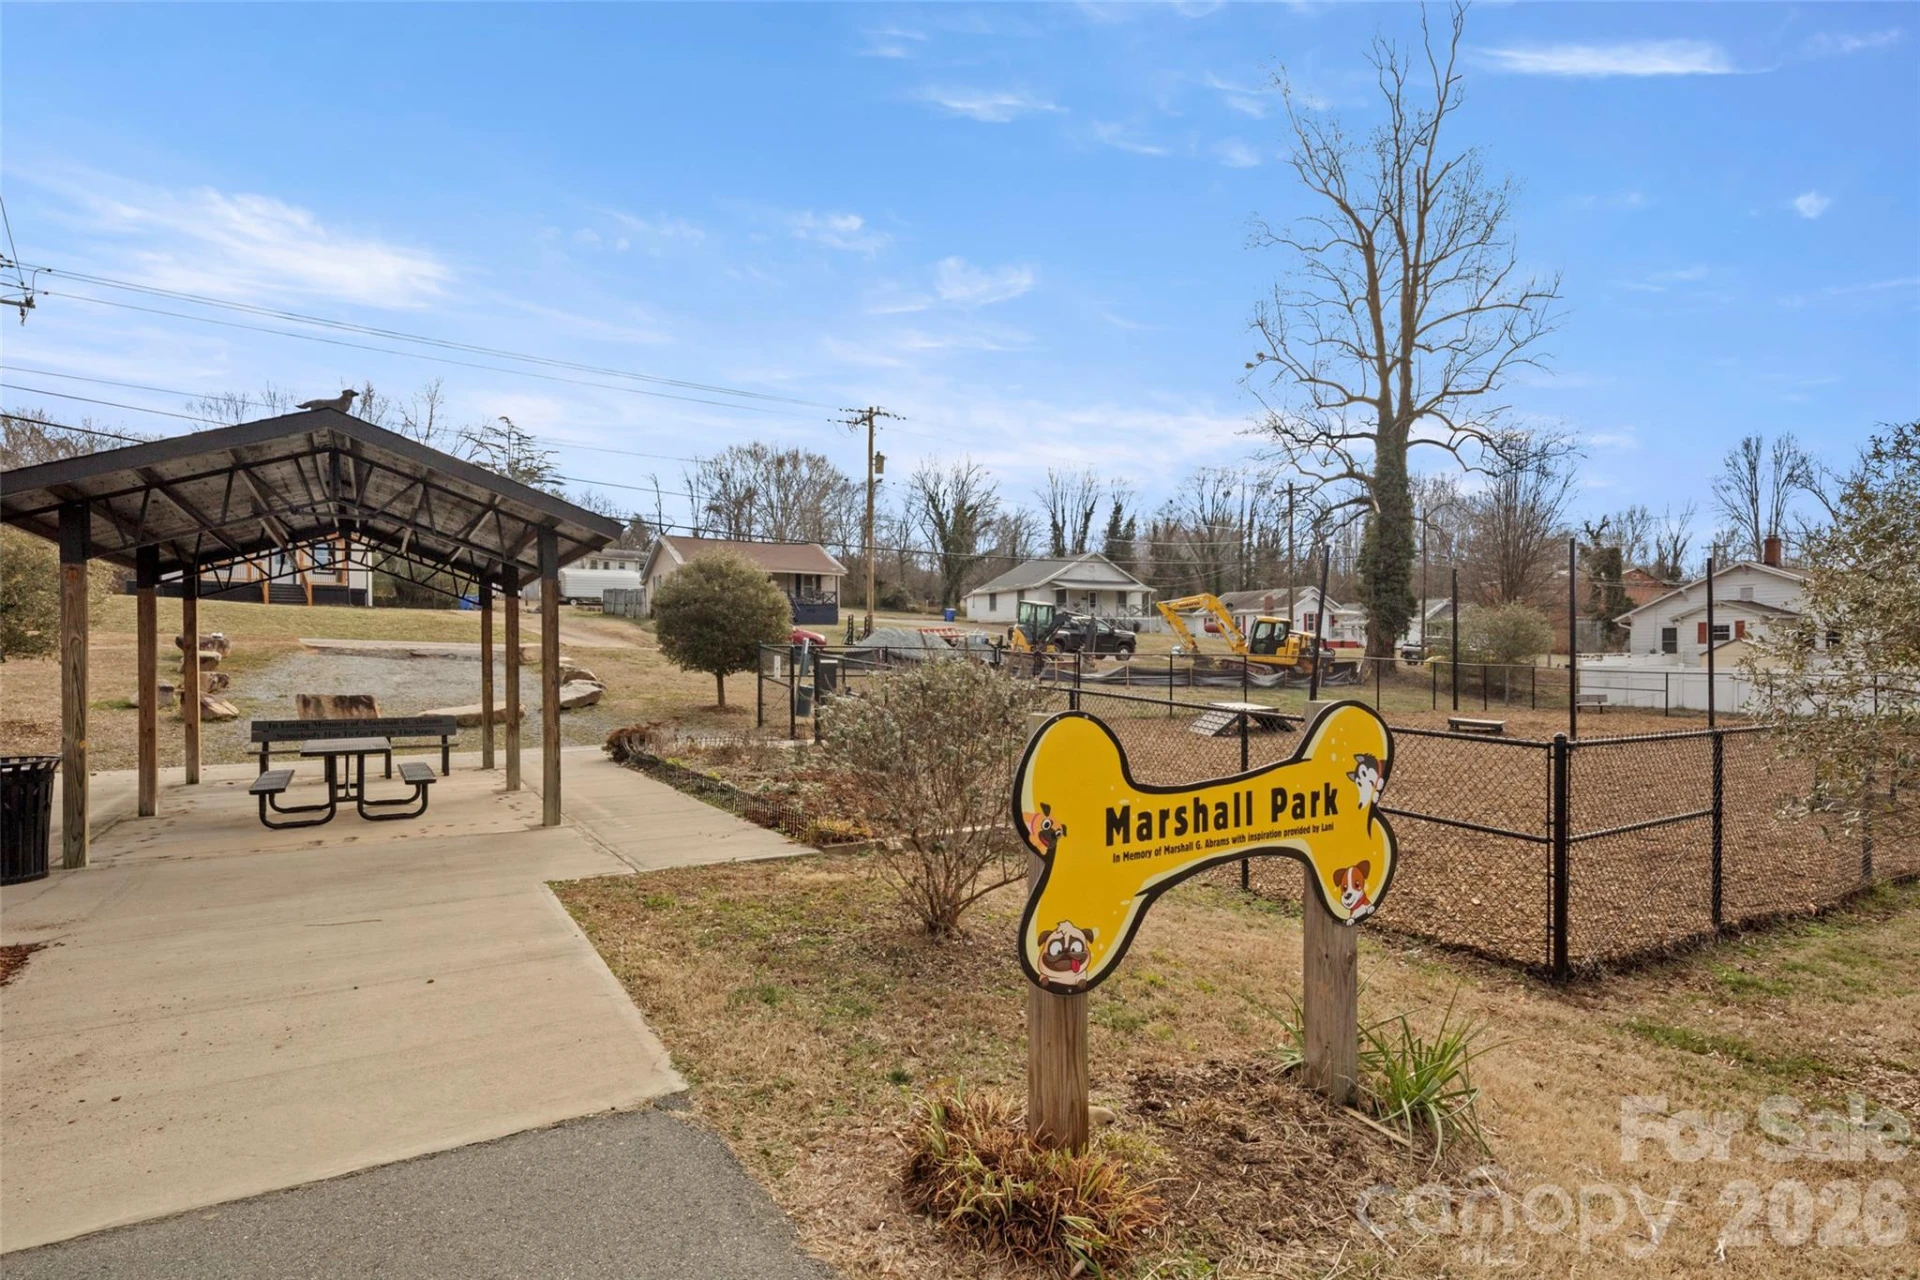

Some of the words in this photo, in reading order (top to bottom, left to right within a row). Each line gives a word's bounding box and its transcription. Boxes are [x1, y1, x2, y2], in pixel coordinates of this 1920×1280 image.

[313, 720, 348, 730] Memory
[363, 718, 399, 727] Marshall
[1105, 790, 1252, 847] Marshall
[1271, 782, 1339, 823] Park
[1112, 853, 1120, 863] In
[1122, 849, 1152, 862] Memory
[1154, 846, 1162, 857] of
[1164, 842, 1193, 855] Marshall
[1195, 840, 1203, 850] G.
[1205, 837, 1230, 849] Abrams
[1232, 834, 1246, 844] with
[1247, 829, 1282, 842] inspiration
[1283, 824, 1310, 837] provided
[1312, 823, 1320, 834] by
[1321, 822, 1334, 832] Lani
